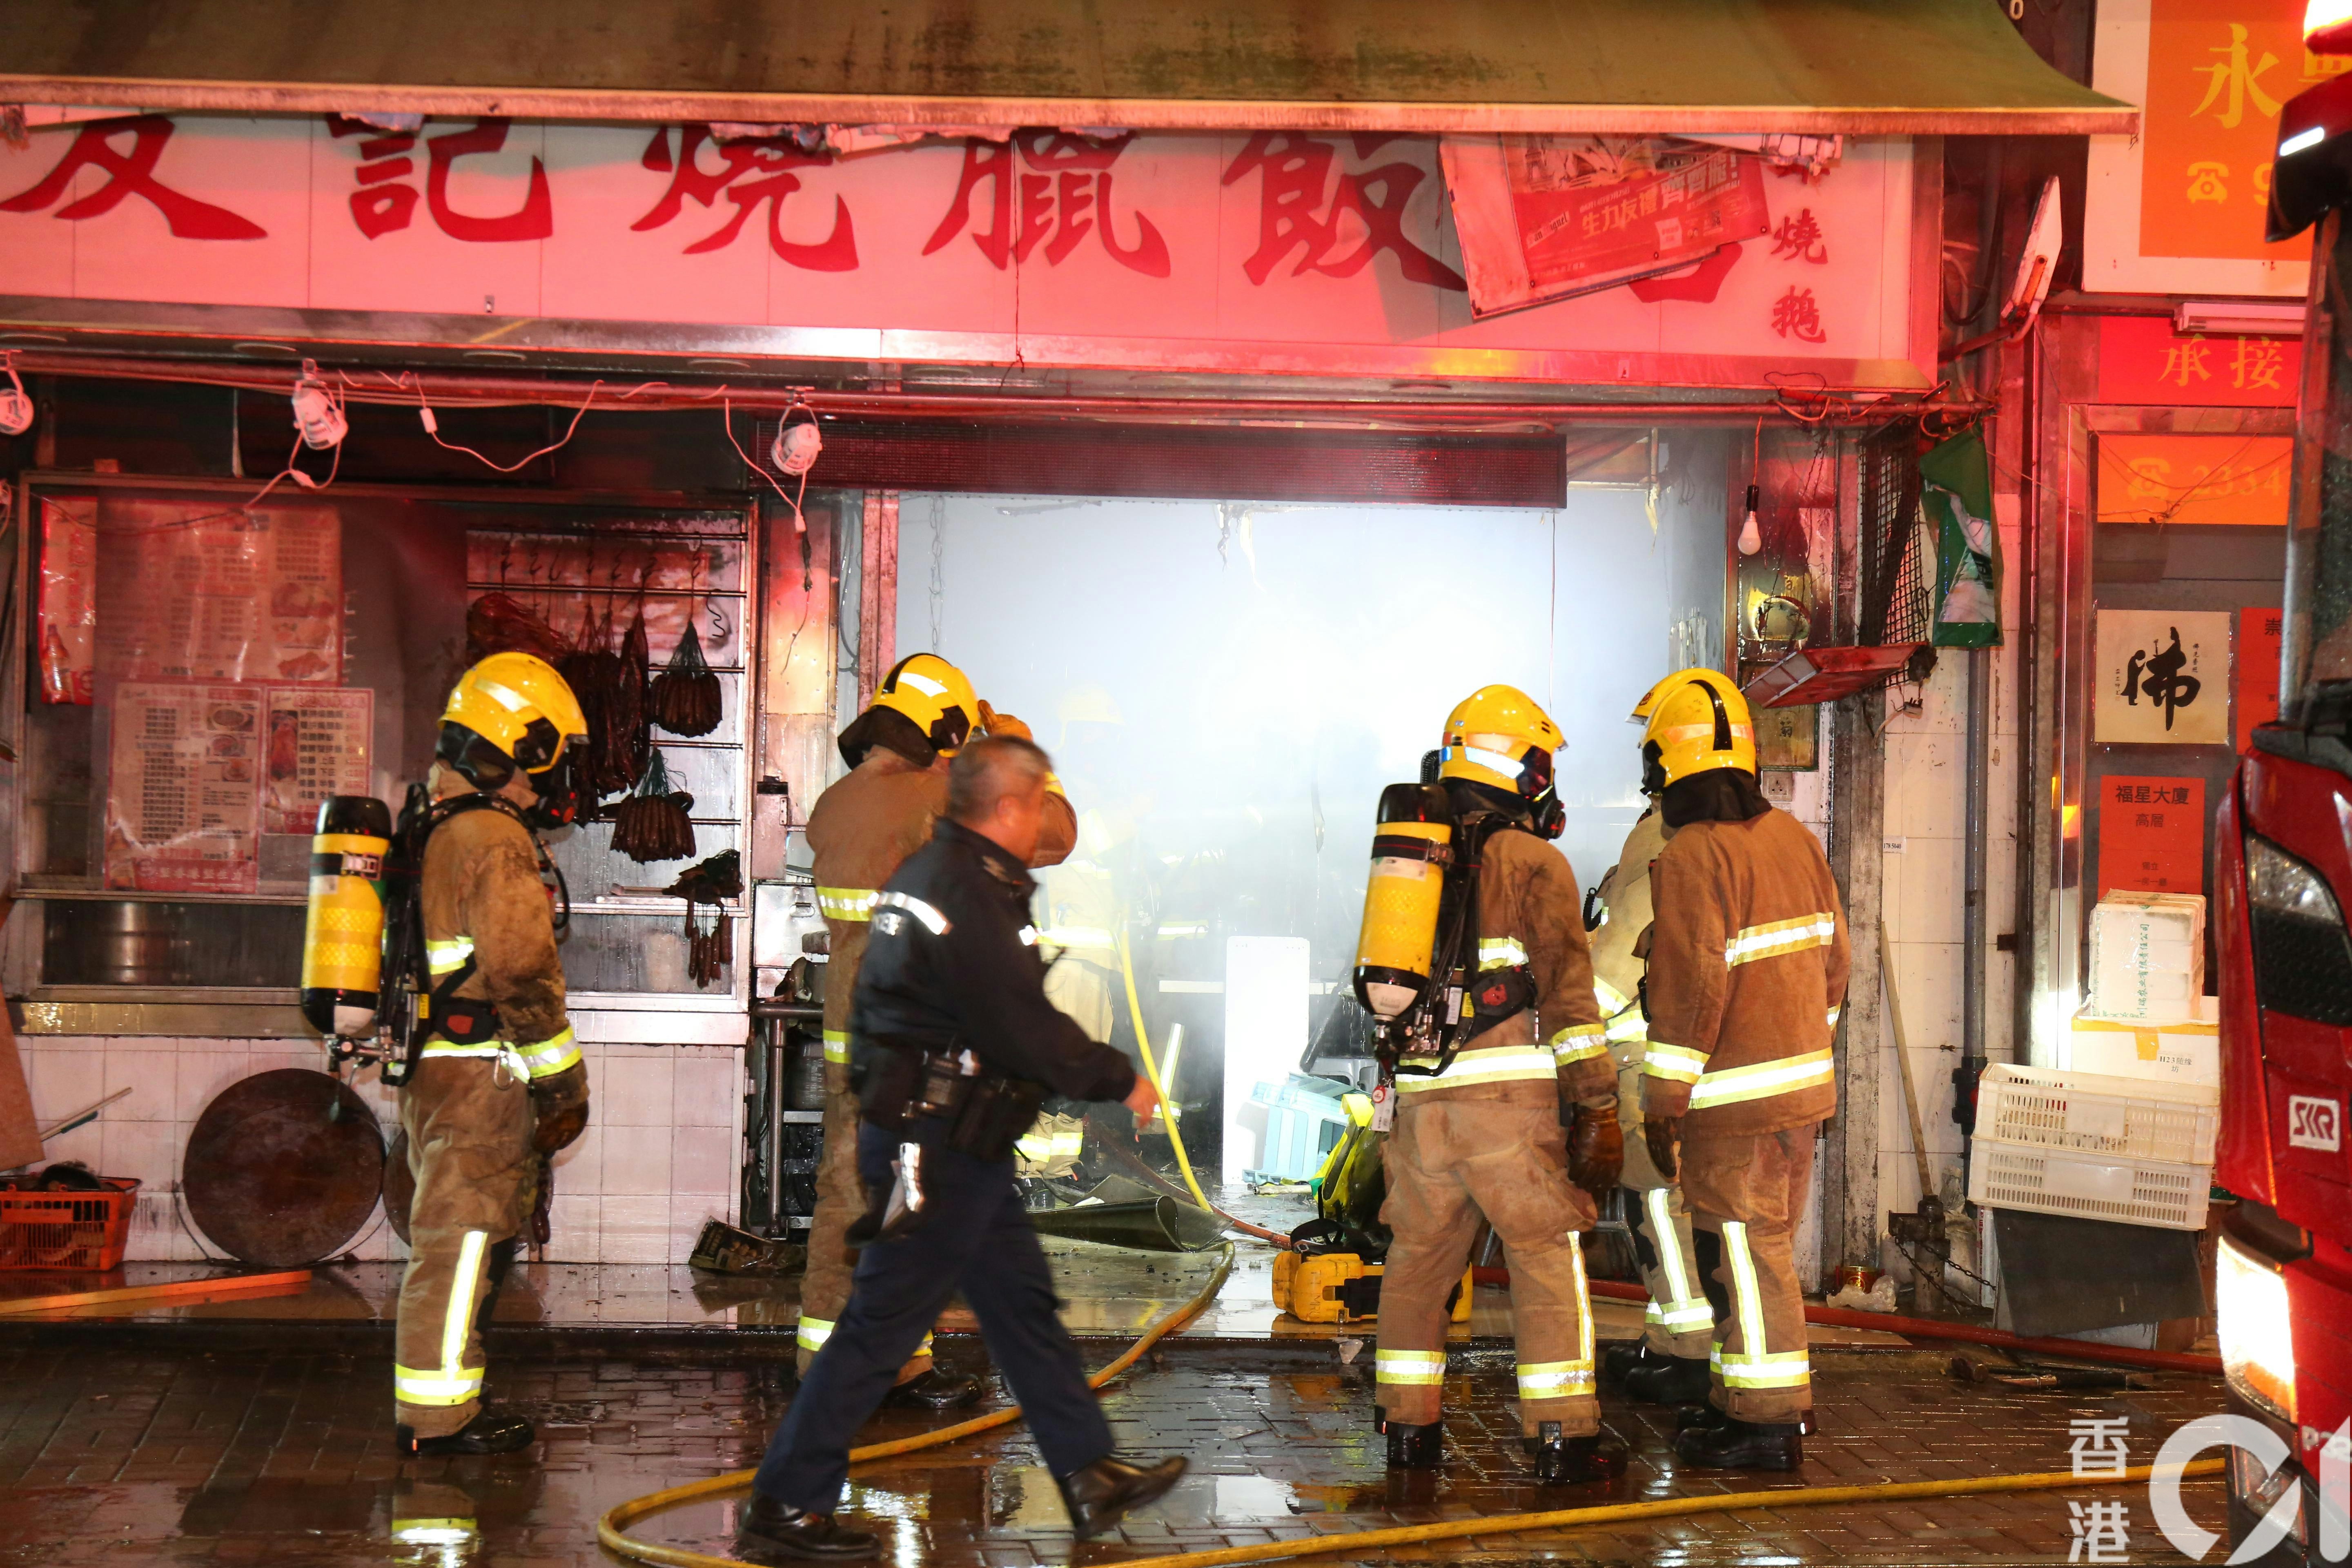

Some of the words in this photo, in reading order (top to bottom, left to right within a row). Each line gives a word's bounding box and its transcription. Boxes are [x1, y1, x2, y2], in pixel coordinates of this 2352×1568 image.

[0, 113, 1743, 303] 友記燒臘飯
[2158, 333, 2283, 390] 承接
[2120, 626, 2201, 731] 佛
[2116, 785, 2189, 805] 福星大廈
[2135, 813, 2164, 828] 高層
